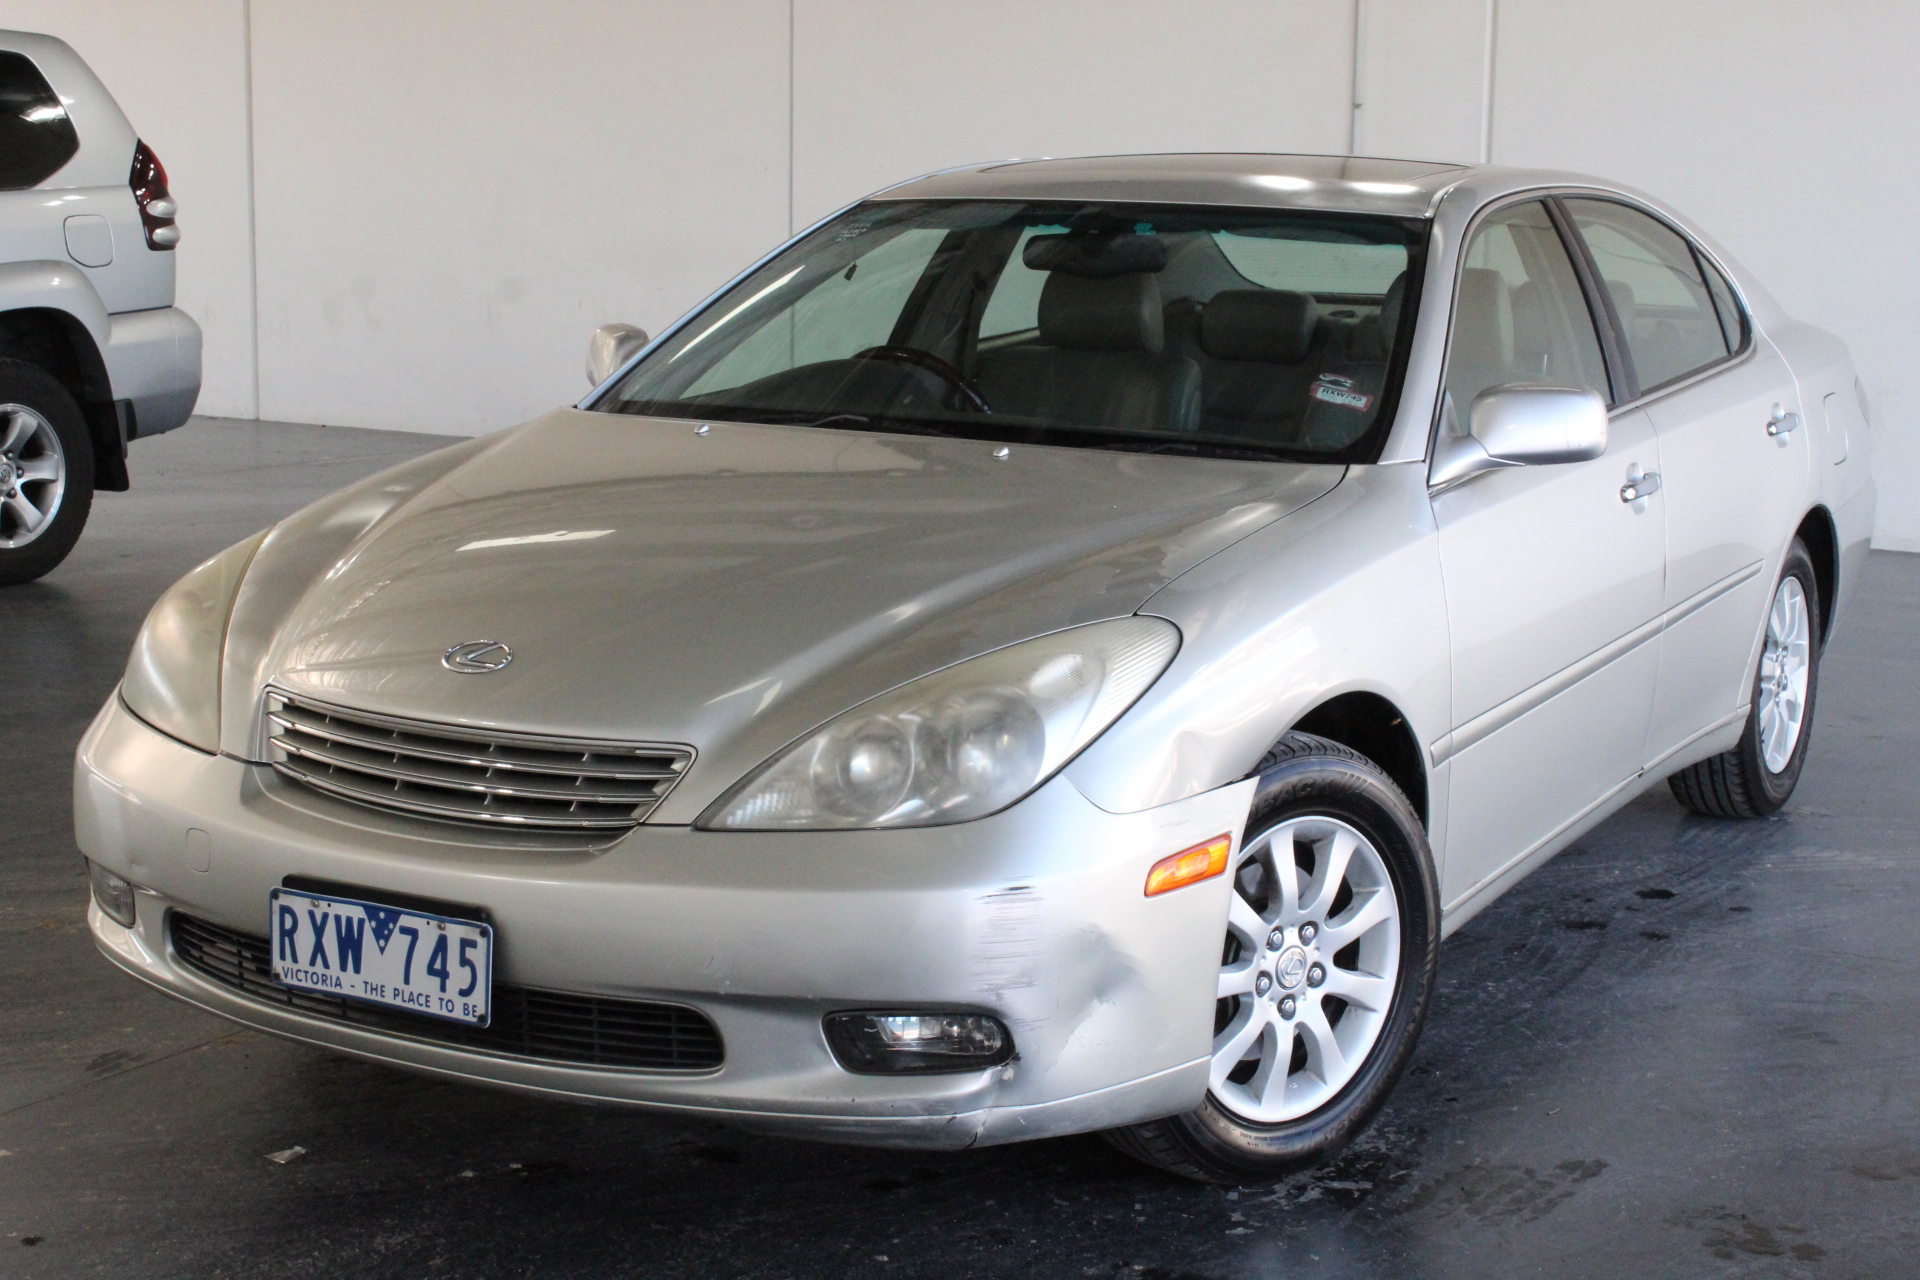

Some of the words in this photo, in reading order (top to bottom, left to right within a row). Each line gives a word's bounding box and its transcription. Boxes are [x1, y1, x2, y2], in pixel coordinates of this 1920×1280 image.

[1322, 388, 1362, 402] RXW745
[279, 904, 366, 975] RXW
[399, 925, 478, 998] 745
[282, 966, 343, 989] VICTORIA
[363, 980, 386, 998] THE
[393, 987, 431, 1009] PLACE
[438, 997, 455, 1013] TO
[463, 1003, 478, 1018] BE
